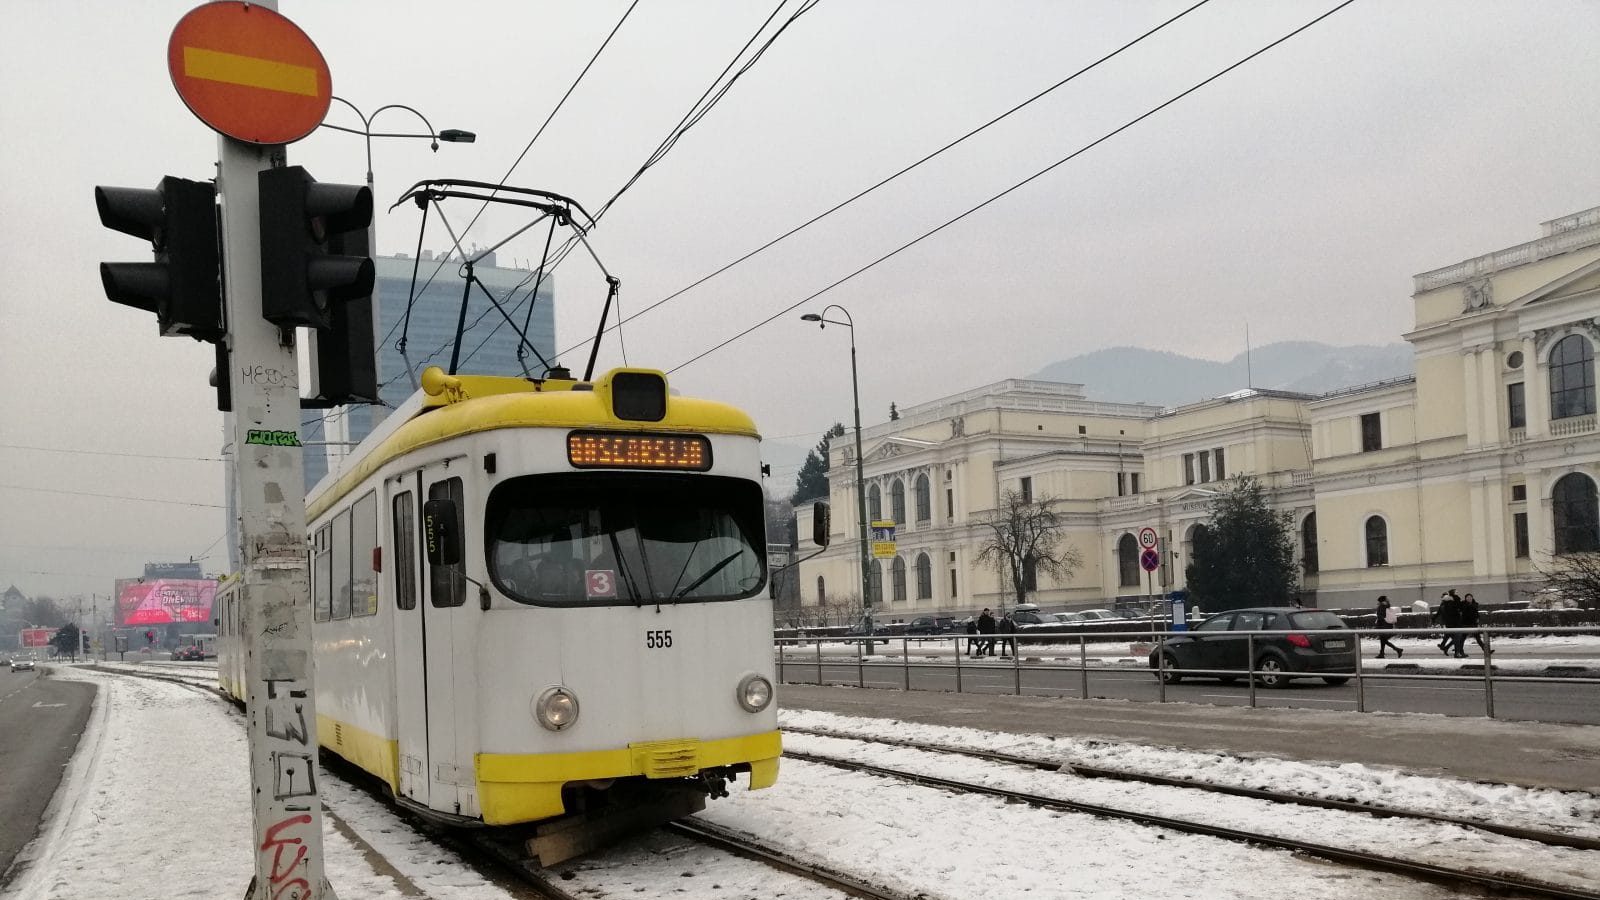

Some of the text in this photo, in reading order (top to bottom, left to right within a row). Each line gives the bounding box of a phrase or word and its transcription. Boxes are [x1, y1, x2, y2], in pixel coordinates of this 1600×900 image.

[426, 514, 436, 553] 555
[1143, 533, 1154, 544] 60
[592, 572, 611, 594] 3
[646, 629, 673, 649] 555
